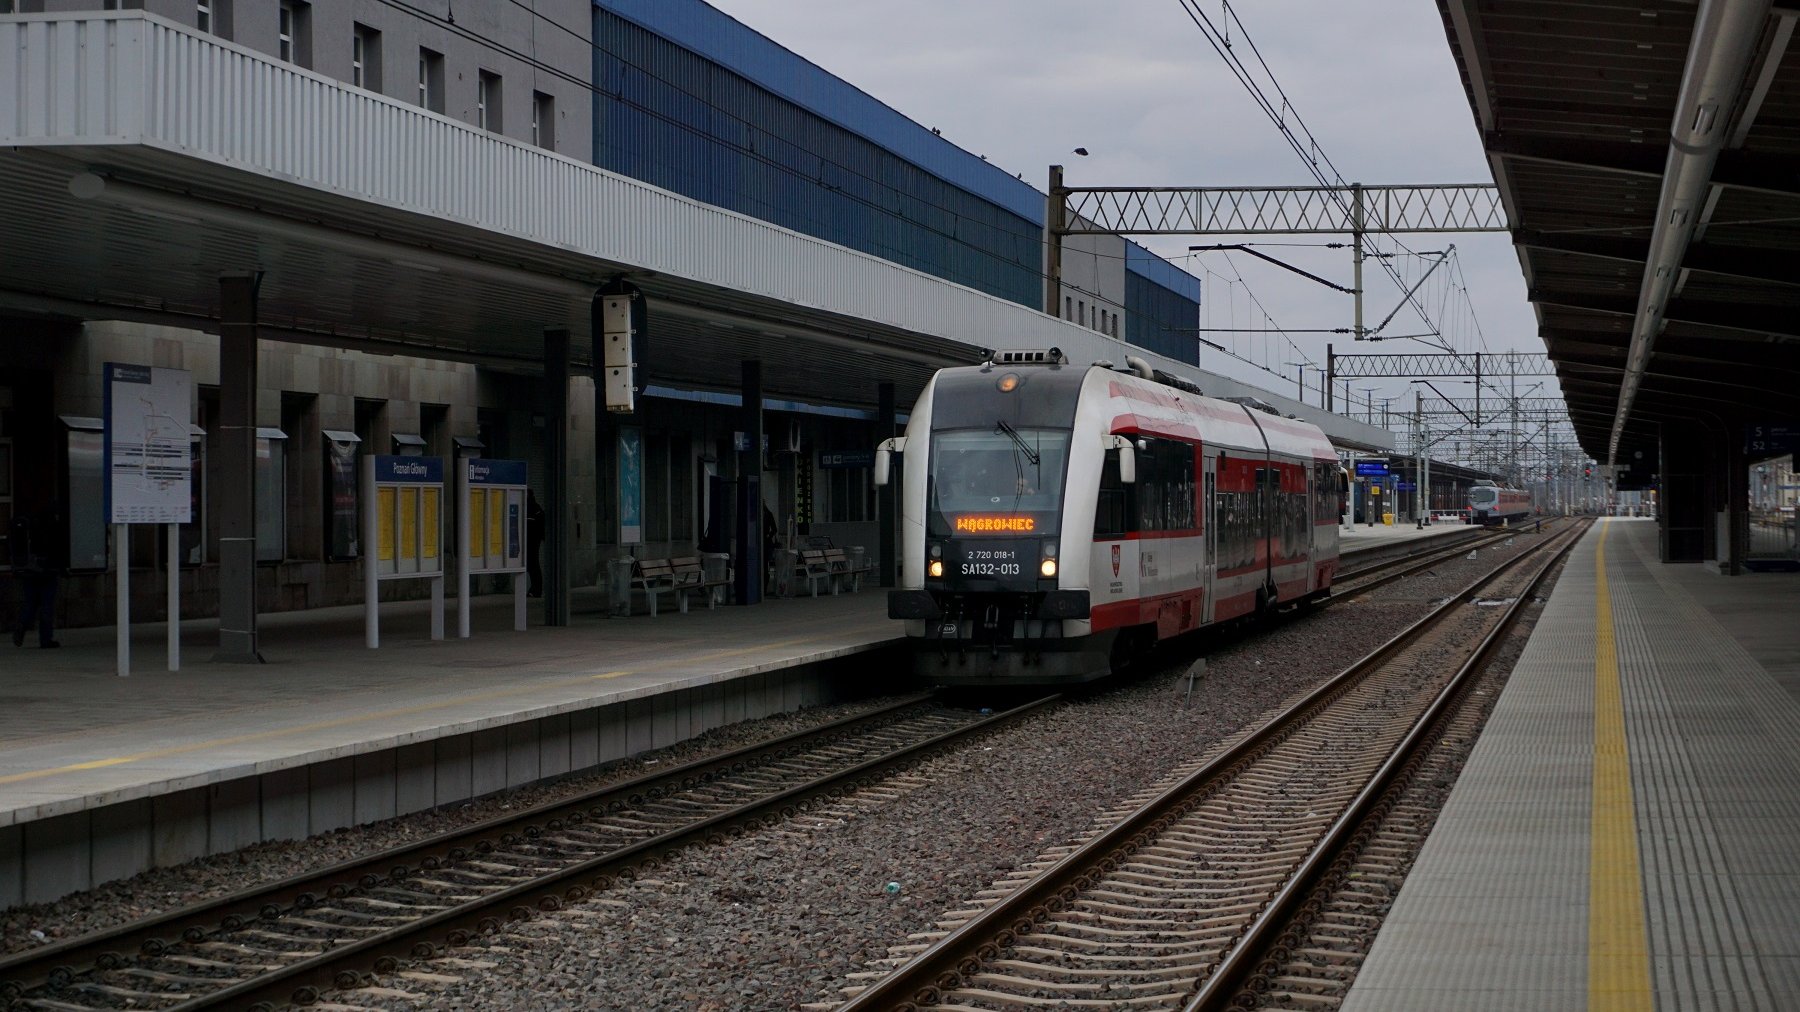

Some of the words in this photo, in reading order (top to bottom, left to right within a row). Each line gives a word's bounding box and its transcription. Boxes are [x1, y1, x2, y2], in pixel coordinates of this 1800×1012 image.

[1754, 426, 1763, 437] 5
[1752, 441, 1766, 450] 52
[393, 462, 411, 474] Poznań
[411, 462, 428, 478] Główny
[957, 518, 1034, 532] WĄGROWIEC
[968, 551, 973, 559] 2
[976, 551, 991, 559] 720
[994, 551, 1015, 559] 018-1
[961, 563, 1020, 575] SA132-013
